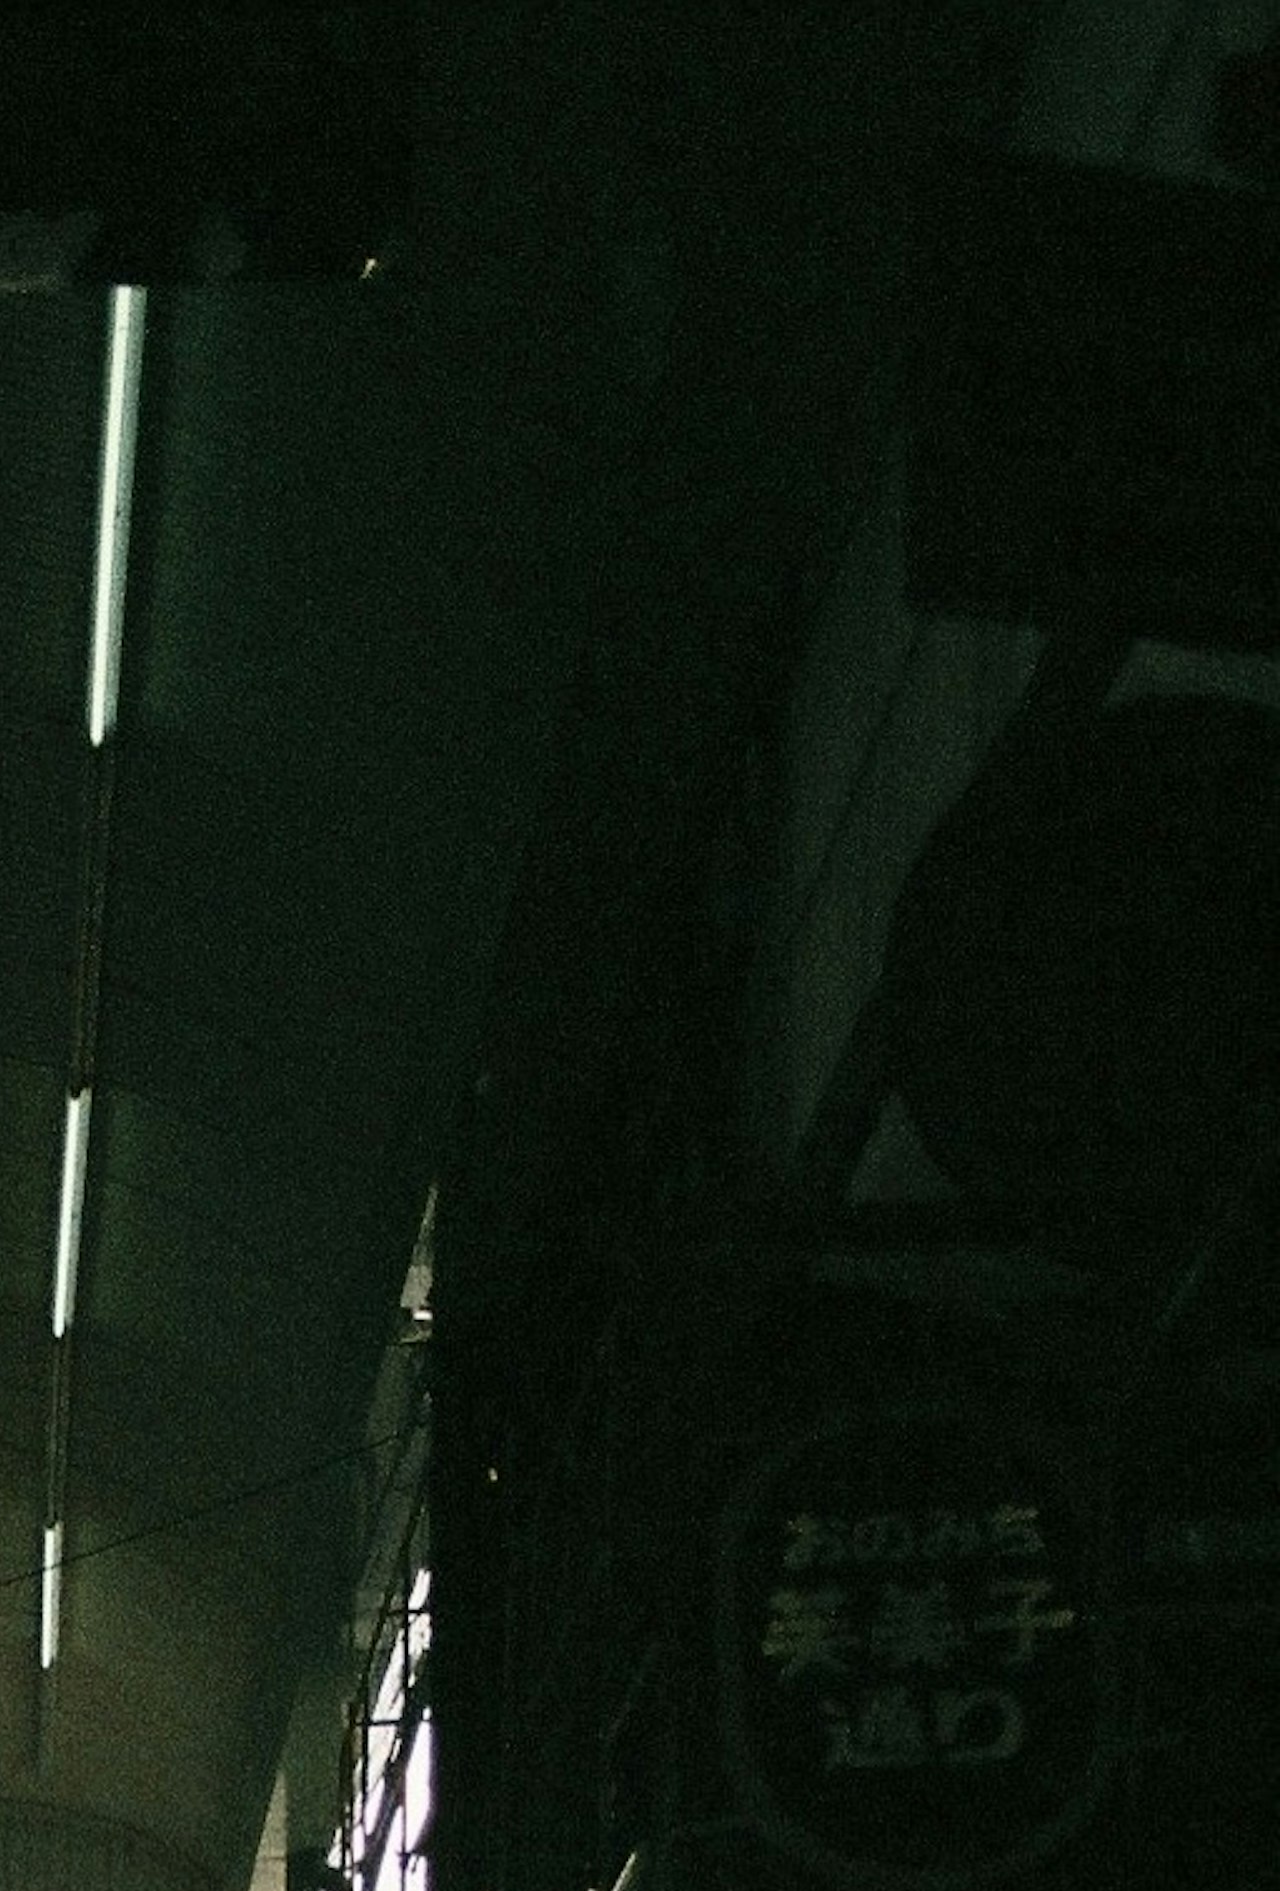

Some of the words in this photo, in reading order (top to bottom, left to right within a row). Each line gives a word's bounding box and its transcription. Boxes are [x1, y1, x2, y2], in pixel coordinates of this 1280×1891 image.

[781, 1502, 1045, 1570] おのみち
[819, 1685, 1026, 1772] 通り
